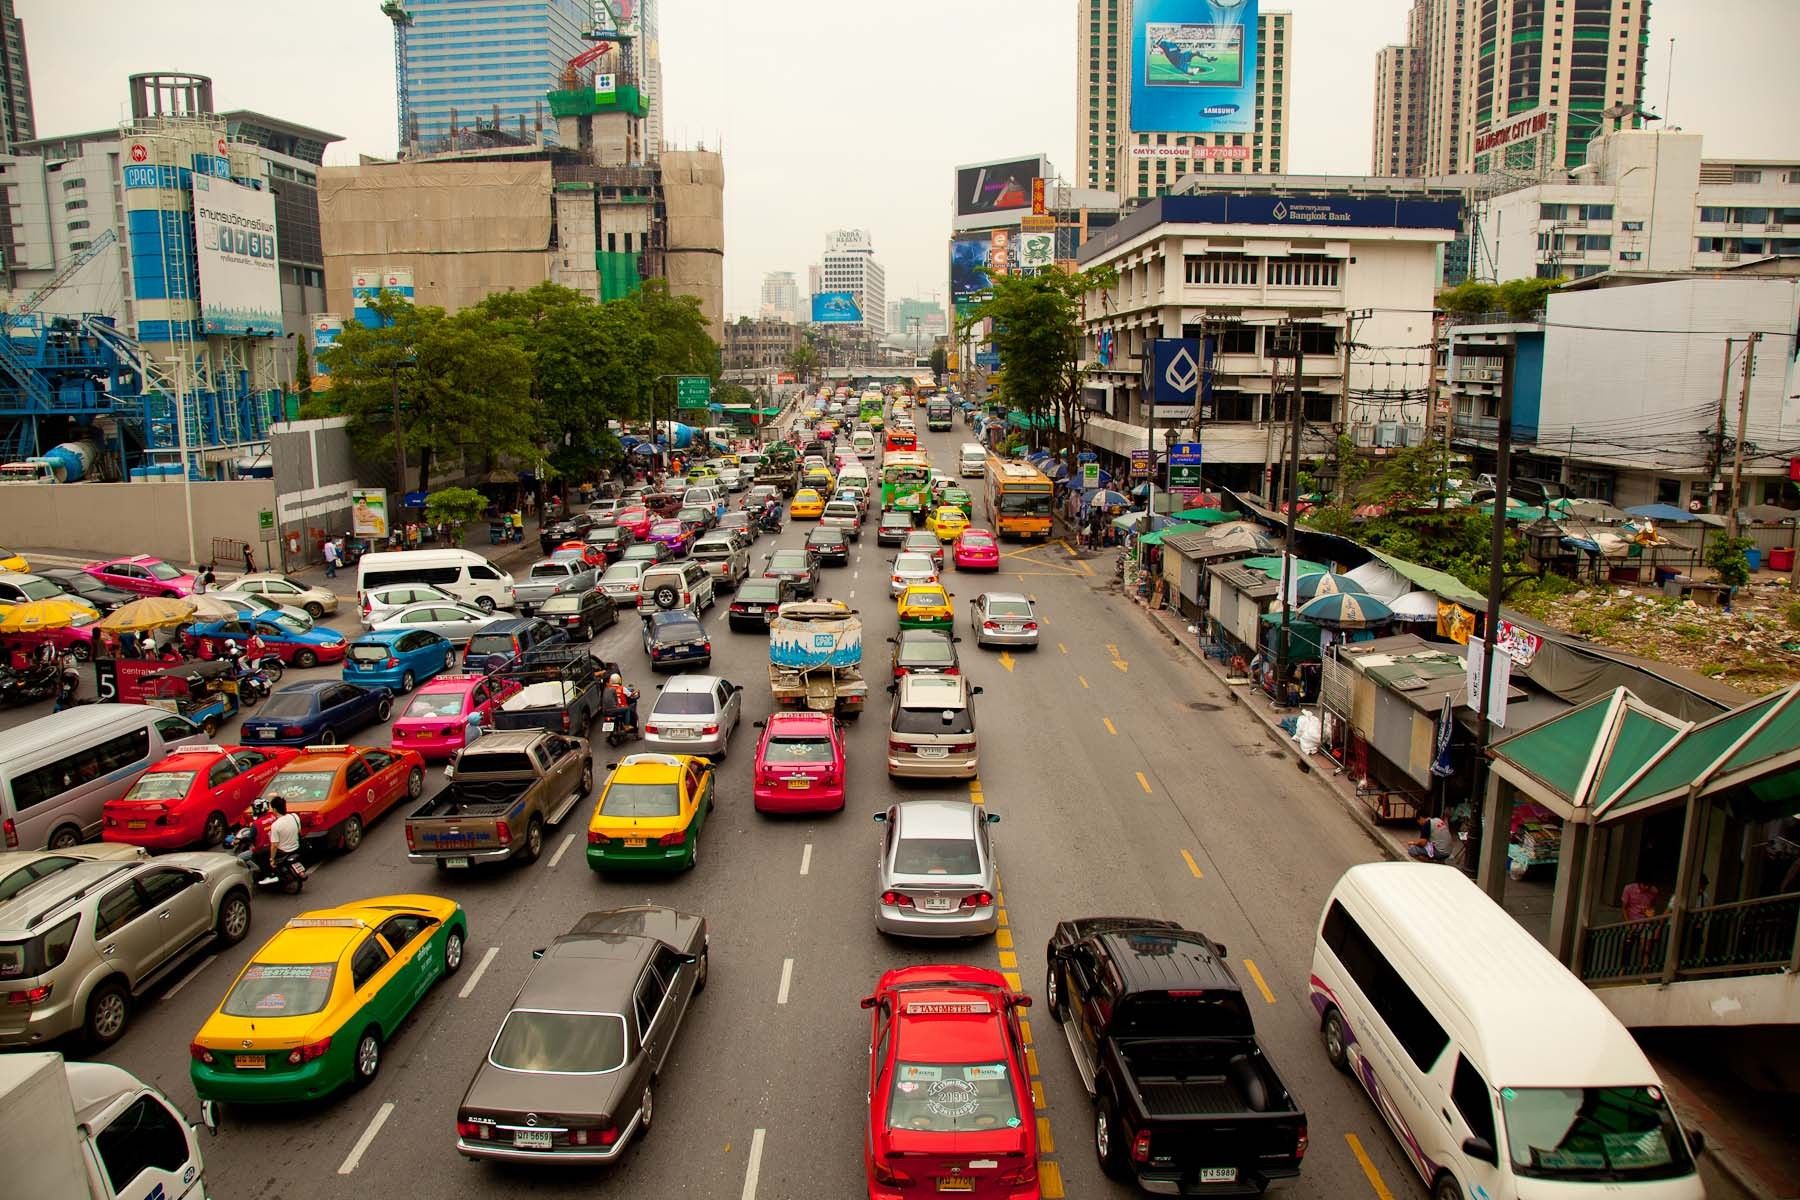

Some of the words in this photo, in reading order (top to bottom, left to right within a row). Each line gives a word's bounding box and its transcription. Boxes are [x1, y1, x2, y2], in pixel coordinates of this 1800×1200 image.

[1512, 117, 1532, 140] CITY
[129, 168, 155, 185] CPAC
[1289, 211, 1327, 222] Bangkok
[1328, 212, 1352, 221] Bank
[222, 231, 272, 256] 1755
[101, 674, 116, 698] 5
[530, 1131, 549, 1141] 5659
[1215, 1168, 1235, 1177] 5989
